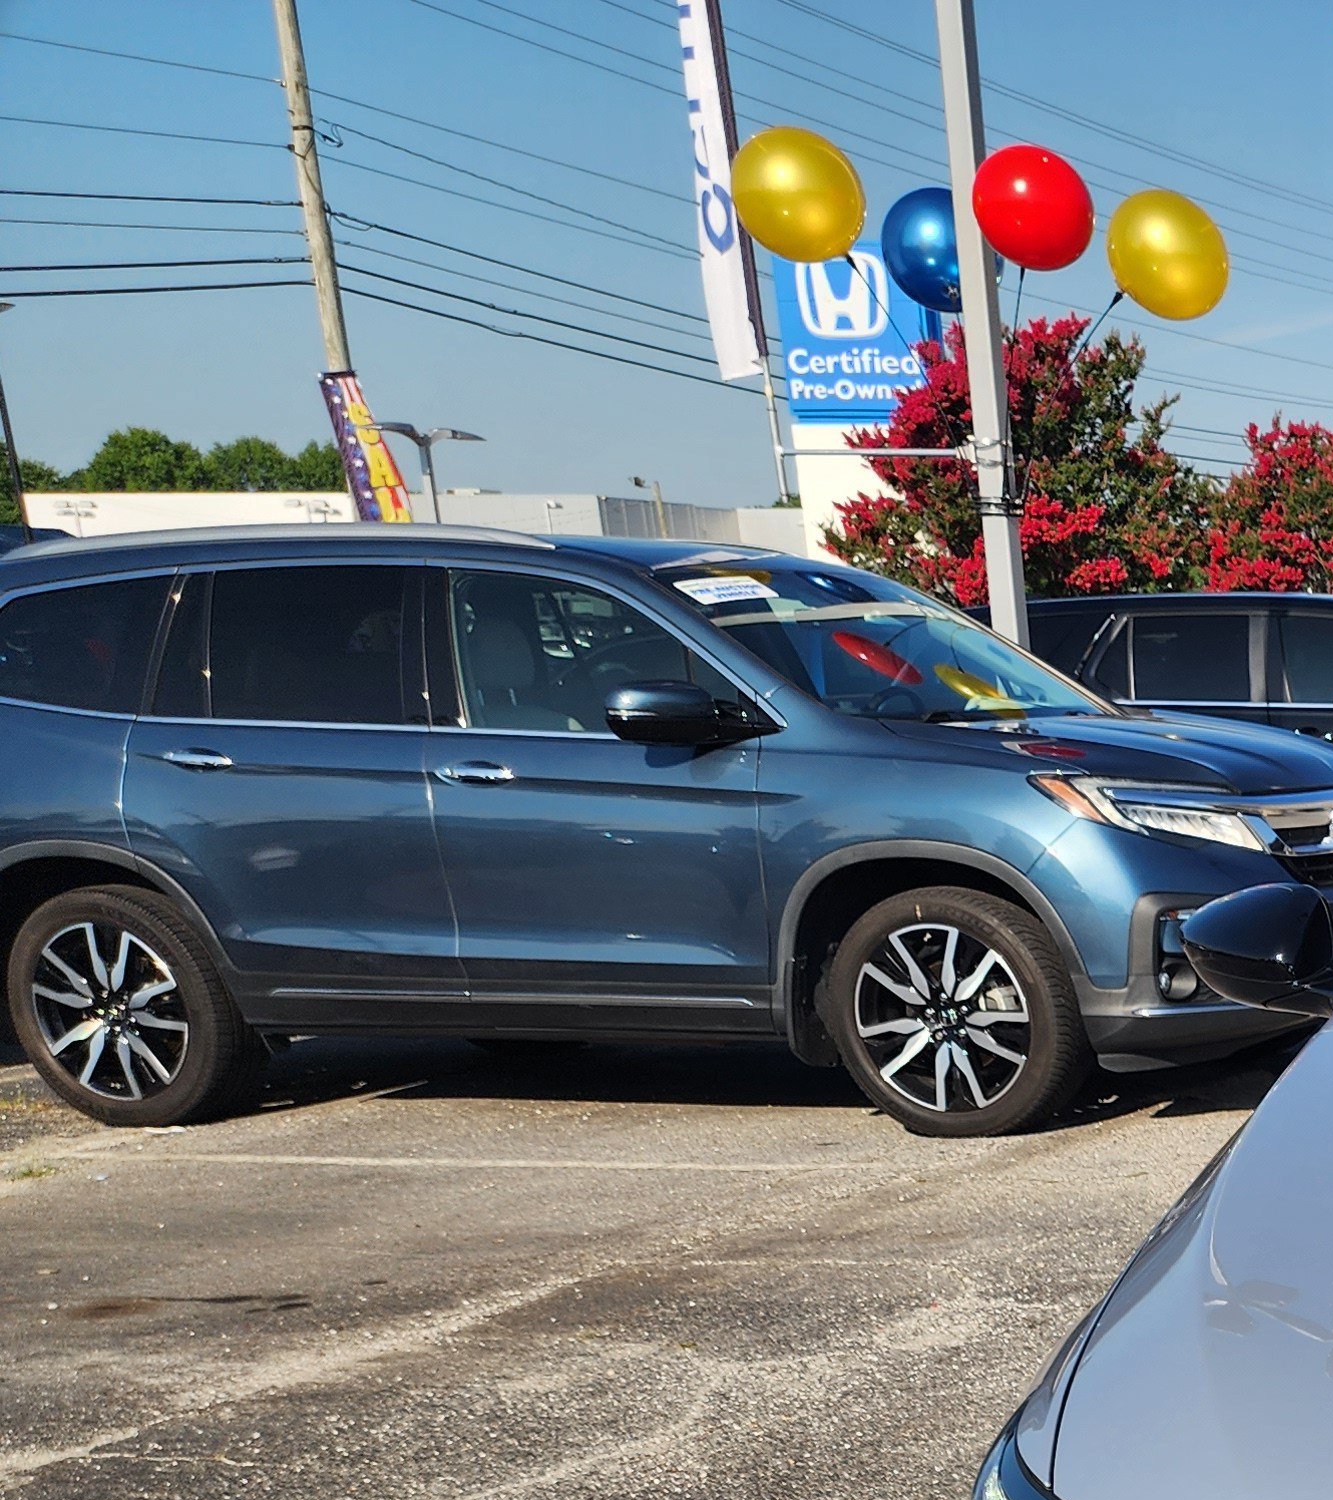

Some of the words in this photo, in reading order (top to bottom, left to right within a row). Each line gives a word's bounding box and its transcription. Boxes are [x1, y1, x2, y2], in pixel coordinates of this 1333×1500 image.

[788, 347, 922, 375] Certified
[789, 379, 922, 401] Pre-Own
[349, 402, 413, 523] SAL
